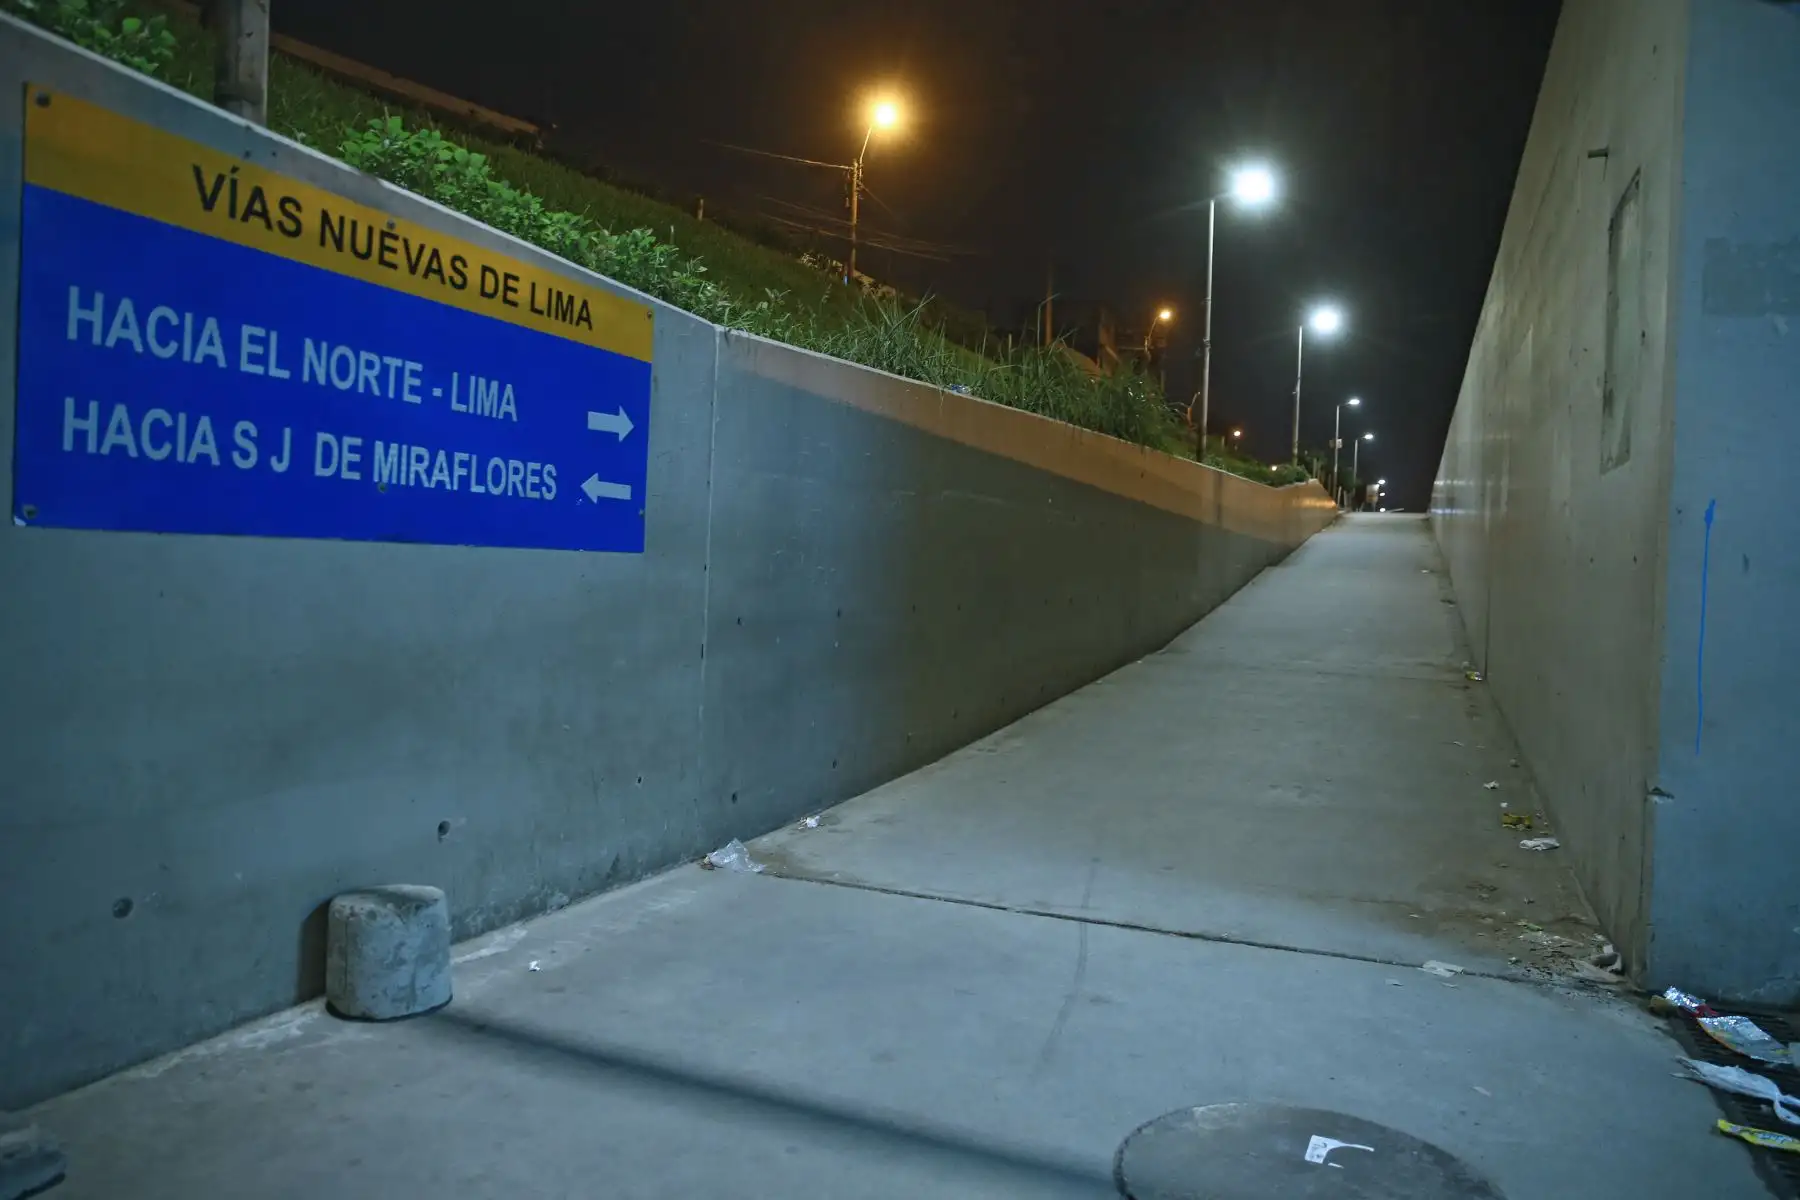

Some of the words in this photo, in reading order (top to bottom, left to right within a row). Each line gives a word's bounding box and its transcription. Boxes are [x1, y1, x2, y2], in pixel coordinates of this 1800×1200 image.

[192, 164, 303, 238] VÍAS
[319, 209, 470, 290] NUEVAS
[480, 264, 520, 307] DE
[529, 281, 594, 331] LIMA
[66, 285, 226, 369] HACIA
[240, 325, 291, 380] EL
[302, 337, 423, 404] NORTE
[451, 371, 517, 422] LIMA
[62, 397, 220, 467] HACIA
[232, 420, 258, 470] S
[271, 427, 291, 473] J
[315, 432, 361, 481] DE
[373, 441, 557, 500] MIRAFLORES
